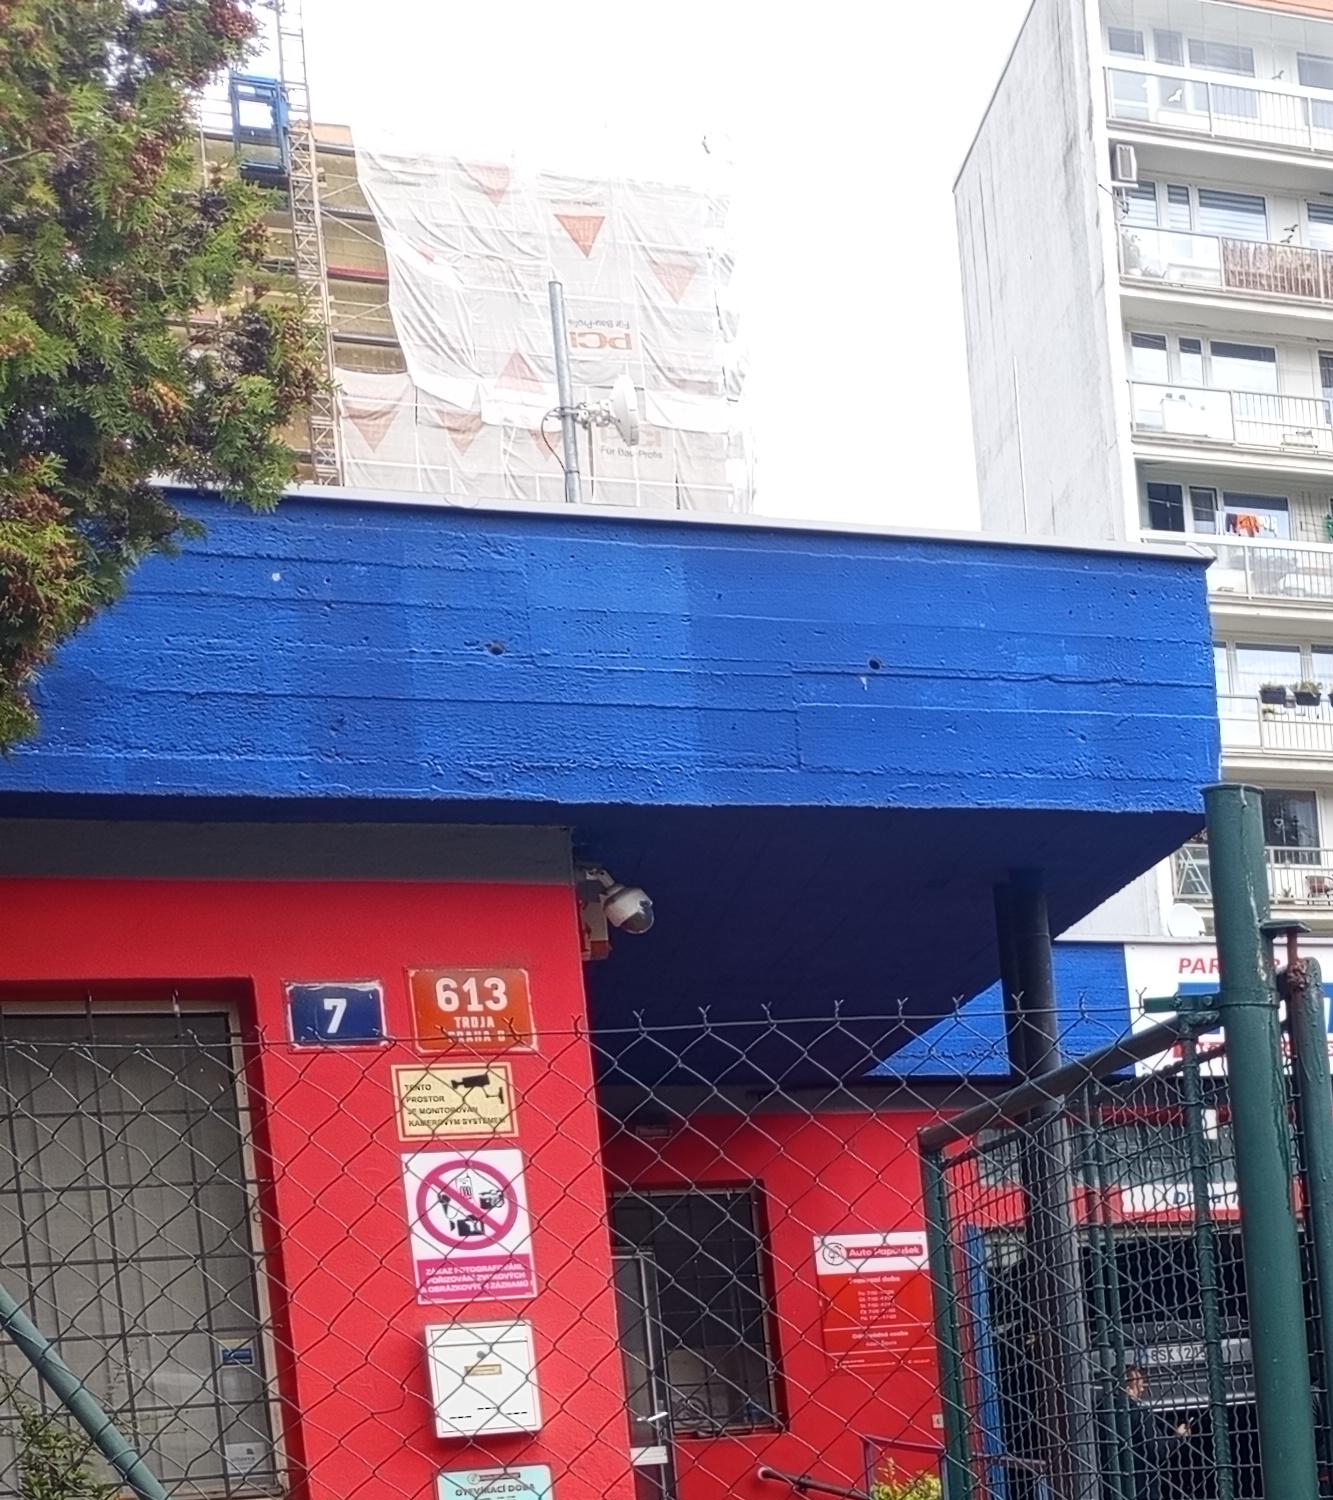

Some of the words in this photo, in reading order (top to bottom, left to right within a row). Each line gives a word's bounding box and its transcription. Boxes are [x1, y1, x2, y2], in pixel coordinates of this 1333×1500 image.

[435, 977, 508, 1012] 613
[324, 998, 347, 1034] 7
[454, 1016, 495, 1028] TROJA
